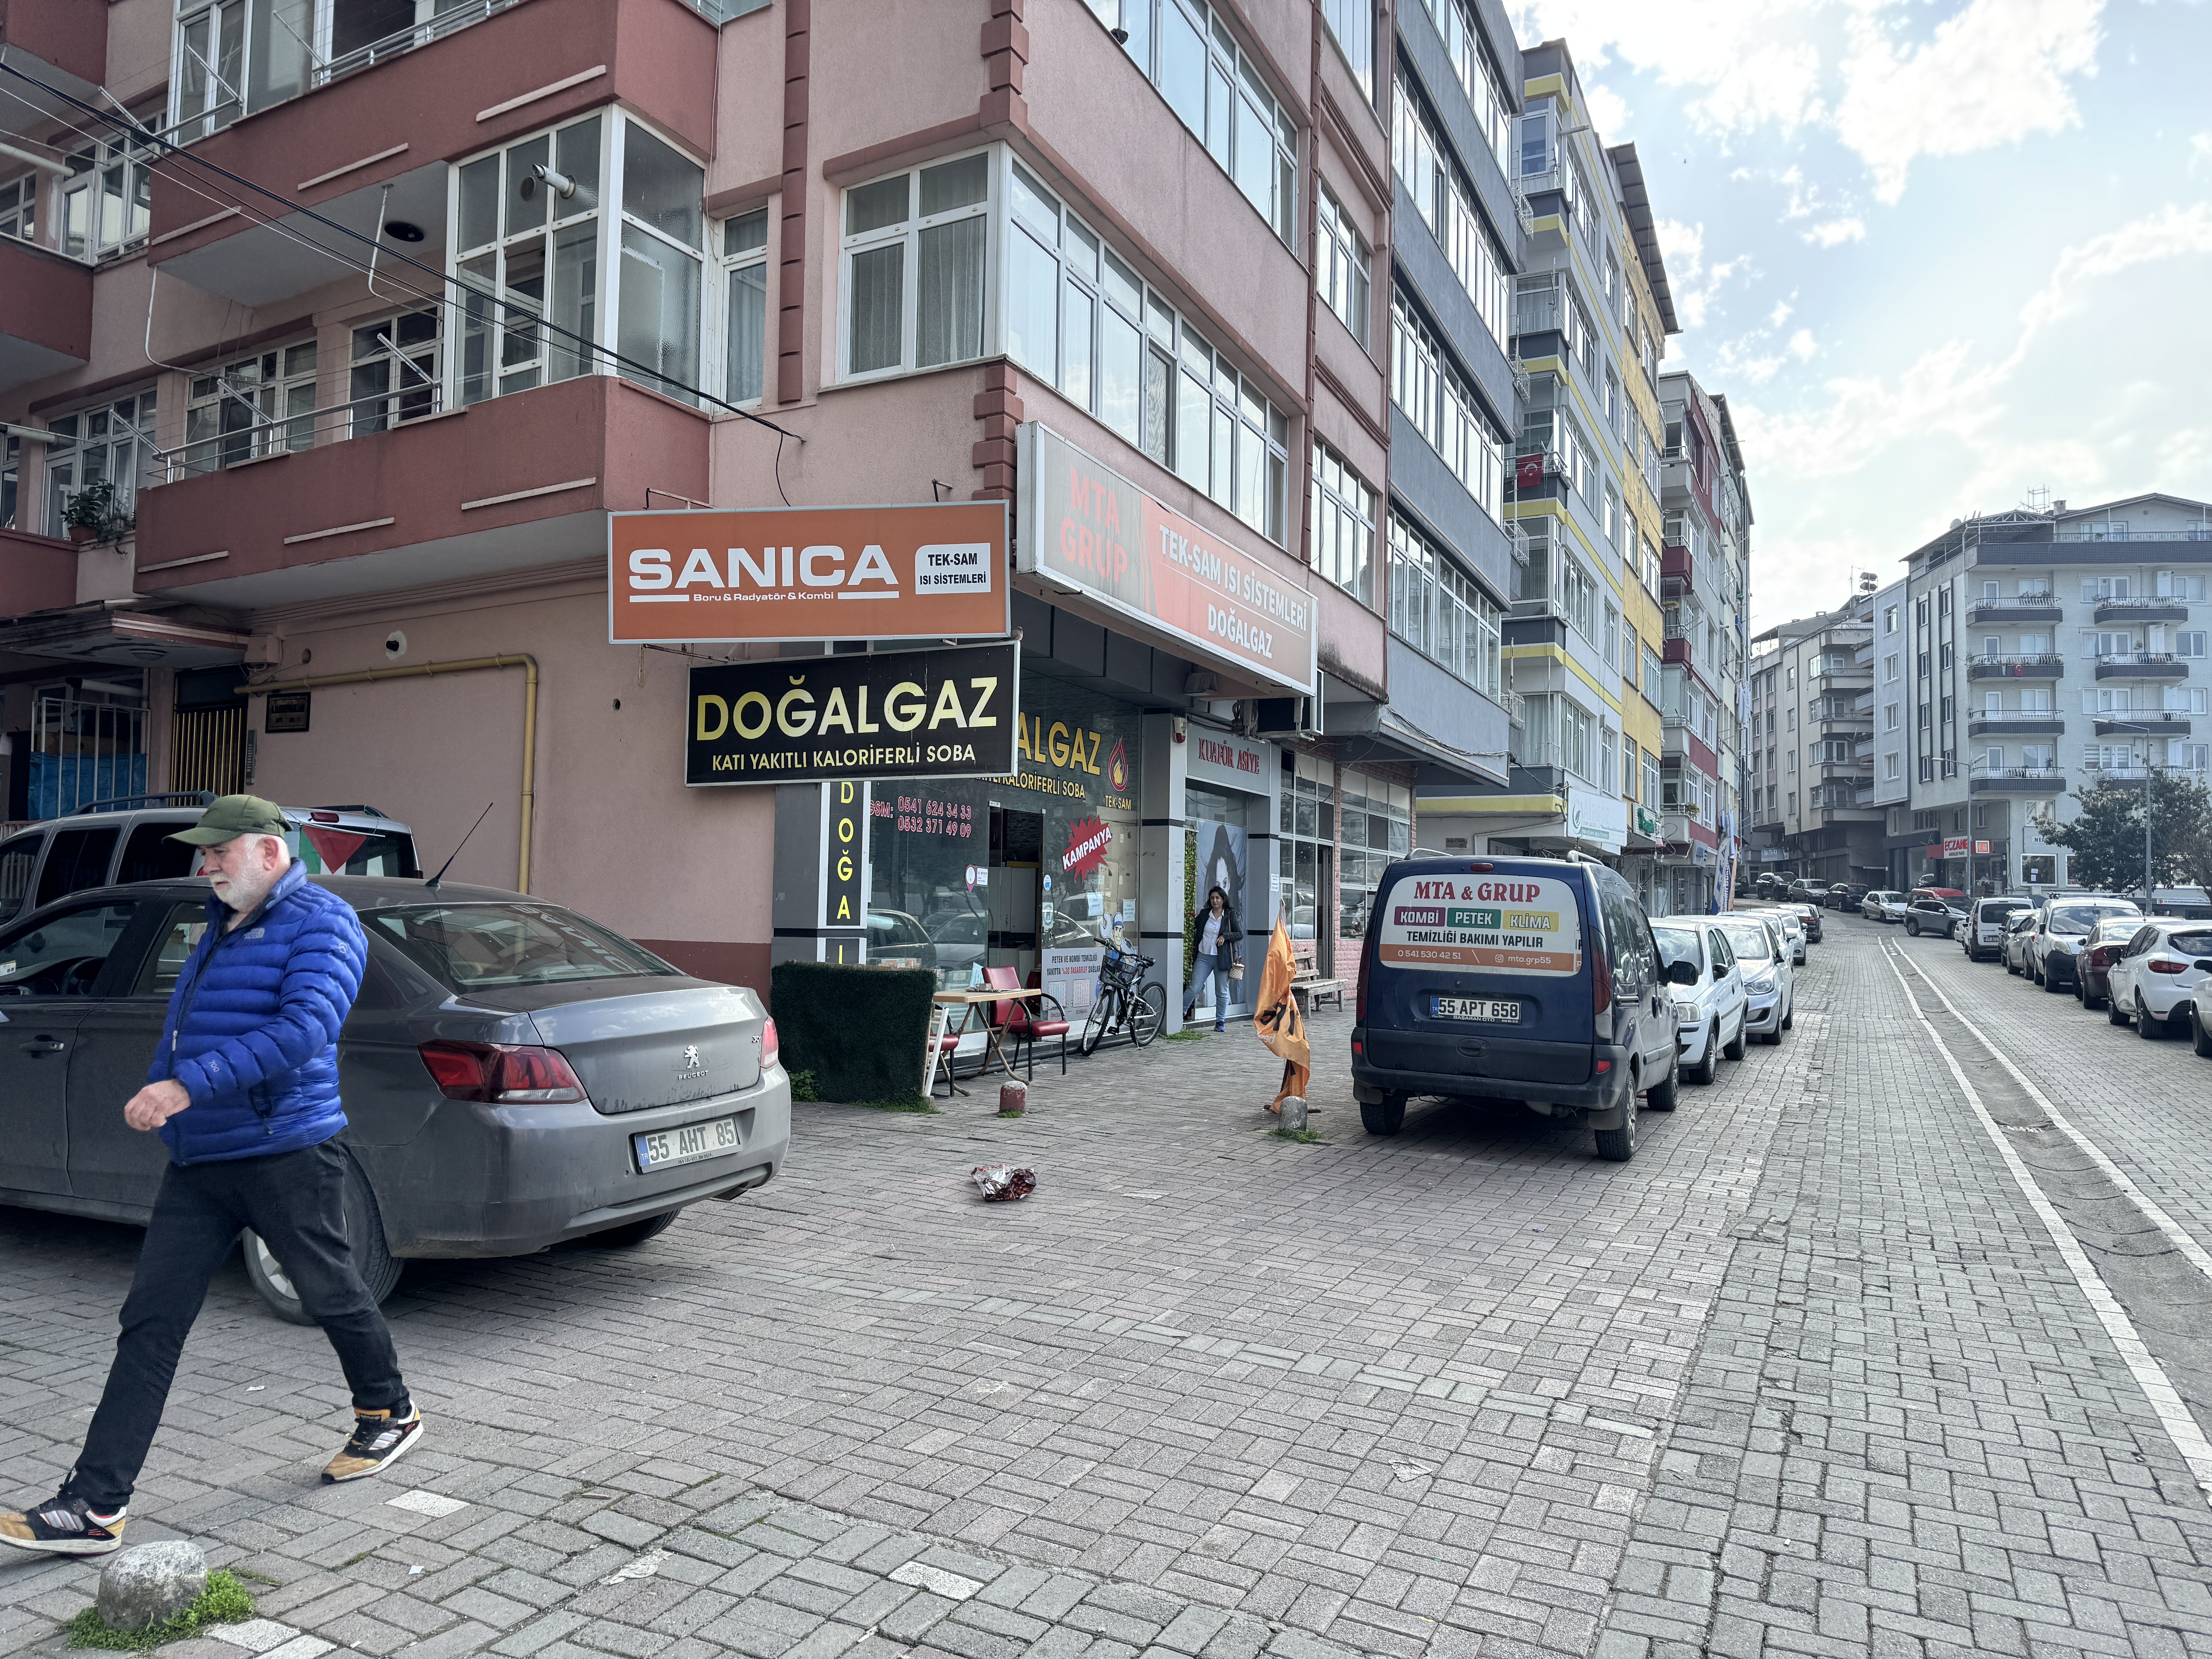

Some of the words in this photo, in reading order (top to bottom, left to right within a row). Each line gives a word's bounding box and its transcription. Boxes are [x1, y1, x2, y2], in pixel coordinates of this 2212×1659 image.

[1070, 467, 1120, 535] MTA
[928, 553, 977, 567] TEK-SAM
[1060, 517, 1128, 584] GRUP
[629, 544, 899, 589] SANICA
[920, 575, 931, 585] ISI
[933, 570, 986, 584] SİSTEMLERİ
[1159, 524, 1221, 585] TEK-SAM
[1224, 562, 1240, 596] ISI
[1243, 570, 1307, 631] SİSTEMLERİ
[694, 594, 721, 602] Boru
[734, 592, 786, 603] Radyatör
[798, 592, 834, 600] Kombi
[1208, 603, 1273, 659] DOĞALGAZ
[697, 675, 997, 741] DOĞALGAZ
[712, 753, 745, 771] KATI
[750, 751, 807, 770] YAKITLI
[812, 742, 920, 766] KALORİFERLİ
[926, 744, 975, 763] SOBA
[1199, 738, 1235, 768] KUAFÖR
[1237, 747, 1259, 774] ASİYE
[1063, 780, 1085, 799] SOBA
[871, 800, 893, 819] GSM:
[898, 796, 922, 814] 0541
[926, 800, 944, 817] 624
[946, 803, 958, 819] 34
[960, 805, 972, 820] 33
[1105, 795, 1132, 811] TEK-SAM
[898, 815, 923, 833] 0532
[926, 818, 943, 834] 371
[946, 821, 958, 836] 49
[960, 823, 972, 838] 09
[1062, 826, 1112, 870] KAMPANYA
[1944, 838, 1968, 851] ECZANE
[1413, 881, 1455, 900] MTA
[1461, 886, 1473, 900] &
[1477, 883, 1540, 902] GRUP
[1400, 910, 1439, 924] KOMBİ
[1455, 912, 1493, 925] PETEK
[1510, 913, 1551, 929] KLİMA
[1407, 930, 1456, 943] TEMİZLİĞİ
[1460, 933, 1499, 945] BAKIMI
[1502, 935, 1543, 948] YAPILIR
[1069, 953, 1080, 962] KOMBİ
[1508, 956, 1551, 965] mta.grp55
[1439, 999, 1455, 1013] 55
[1460, 1000, 1486, 1015] APT
[1492, 1003, 1518, 1018] 658
[208, 1060, 220, 1072] 700
[678, 1070, 709, 1080] PEUGEOT
[647, 1134, 670, 1161] 55
[679, 1126, 706, 1155] AHT
[716, 1121, 735, 1146] 85
